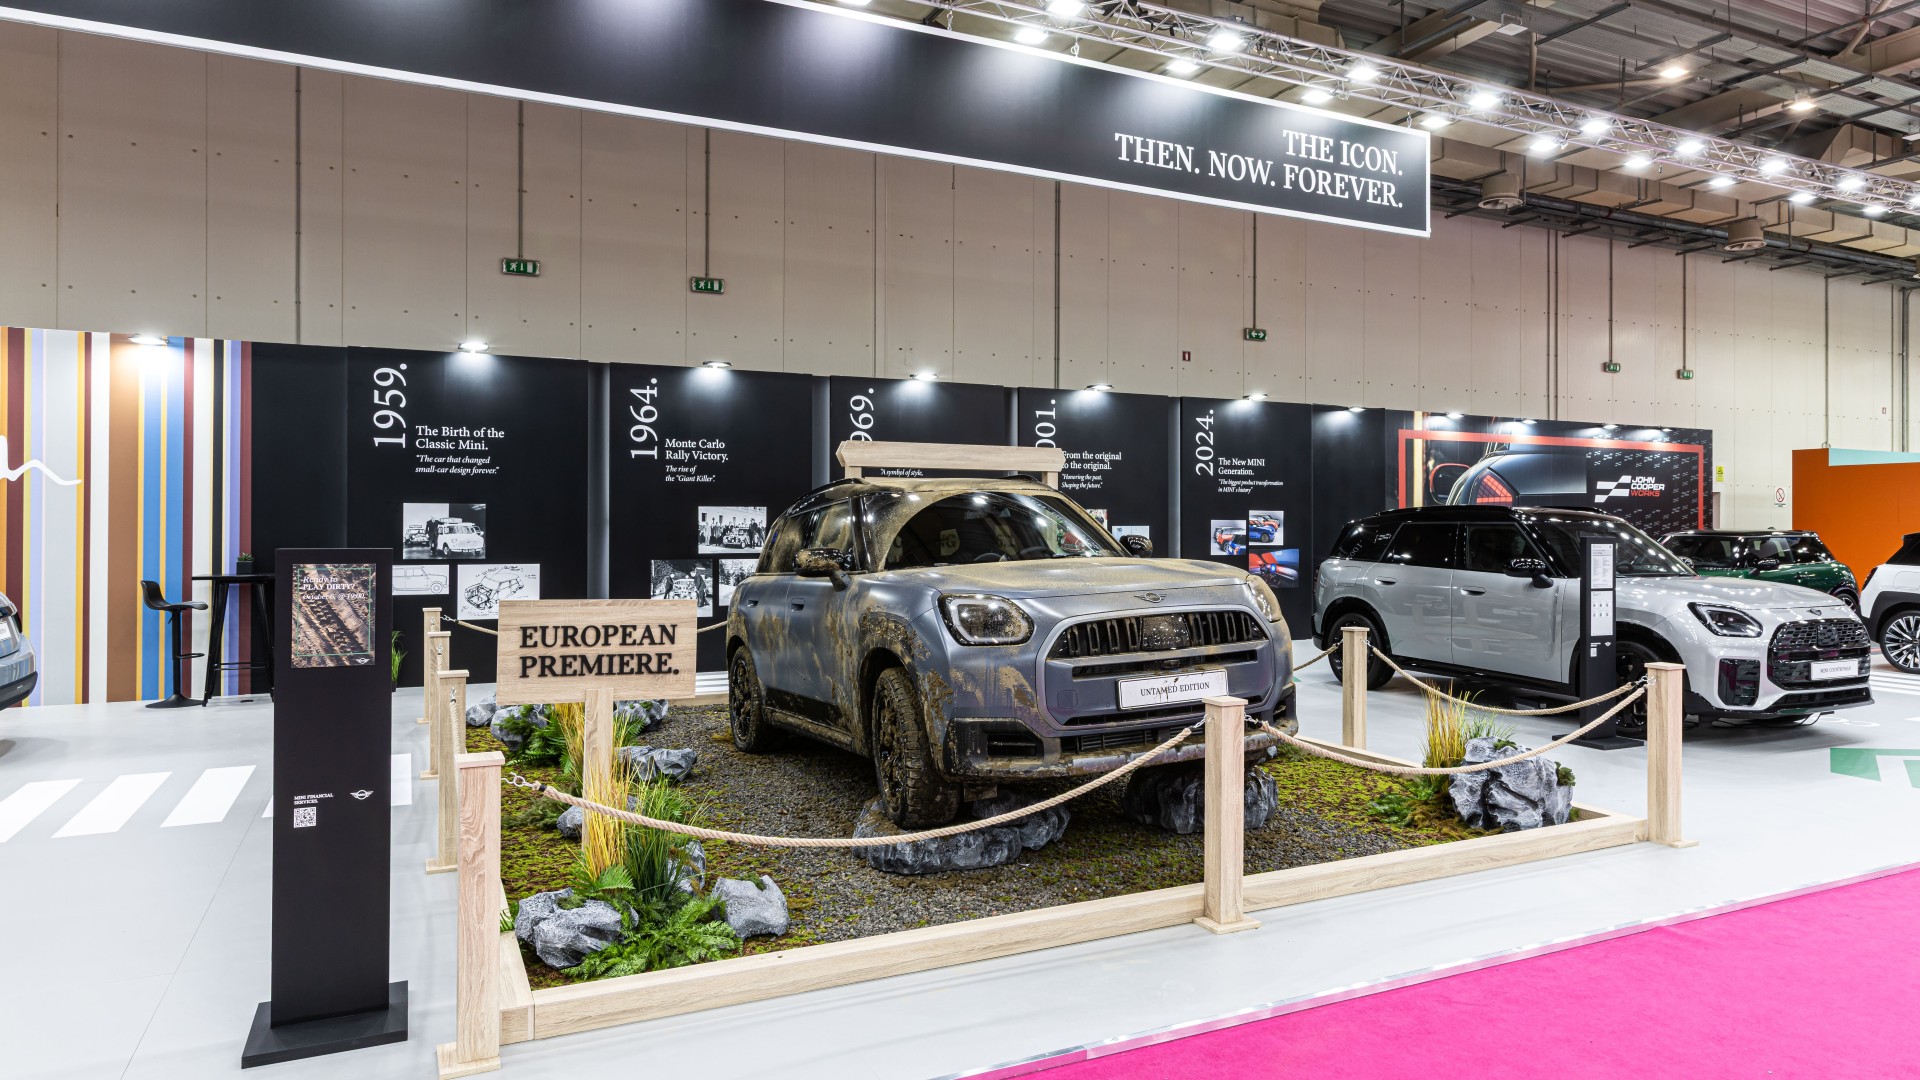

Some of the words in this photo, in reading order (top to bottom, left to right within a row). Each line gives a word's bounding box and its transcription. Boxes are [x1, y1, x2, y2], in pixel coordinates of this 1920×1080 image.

[1283, 129, 1334, 163] THE
[1340, 140, 1403, 176] ICON.
[1115, 132, 1200, 174] THEN.
[1208, 150, 1276, 187] NOW.
[1283, 163, 1403, 208] FOREVER.
[373, 363, 408, 449] 1959.
[630, 377, 658, 460] 1964.
[415, 425, 439, 436] The
[441, 426, 471, 438] Birth
[473, 427, 486, 438] of
[487, 427, 505, 438] the
[415, 438, 456, 450] Classic
[458, 440, 489, 450] Mini.
[664, 438, 697, 448] Monte
[698, 438, 726, 449] Carlo
[1195, 409, 1214, 477] 2024.
[447, 455, 461, 463] that
[462, 456, 490, 465] changed
[665, 450, 691, 462] Rally
[691, 450, 729, 463] Victory.
[1082, 450, 1094, 459] the
[1094, 451, 1122, 462] original
[1070, 460, 1082, 469] the
[1083, 461, 1112, 472] original.
[1218, 457, 1231, 466] The
[1232, 458, 1247, 466] New
[1247, 458, 1266, 467] MINI
[415, 465, 448, 473] small-car
[449, 466, 471, 475] design
[665, 464, 678, 473] The
[689, 465, 698, 475] of
[886, 468, 905, 477] symbol
[904, 468, 912, 478] of
[1218, 467, 1255, 475] Generation.
[665, 474, 675, 482] the
[1241, 479, 1256, 487] product
[1256, 479, 1284, 487] transformation
[1632, 476, 1656, 484] JOHN
[1061, 481, 1080, 489] Shaping
[1631, 483, 1665, 491] COOPER
[1631, 489, 1661, 497] WORKS
[303, 576, 328, 585] Ready
[303, 583, 325, 591] PLAY
[519, 624, 678, 648] EUROPEAN
[519, 653, 680, 678] PREMIERE.
[1140, 684, 1178, 696] UNTAMED
[1179, 682, 1210, 693] EDITION
